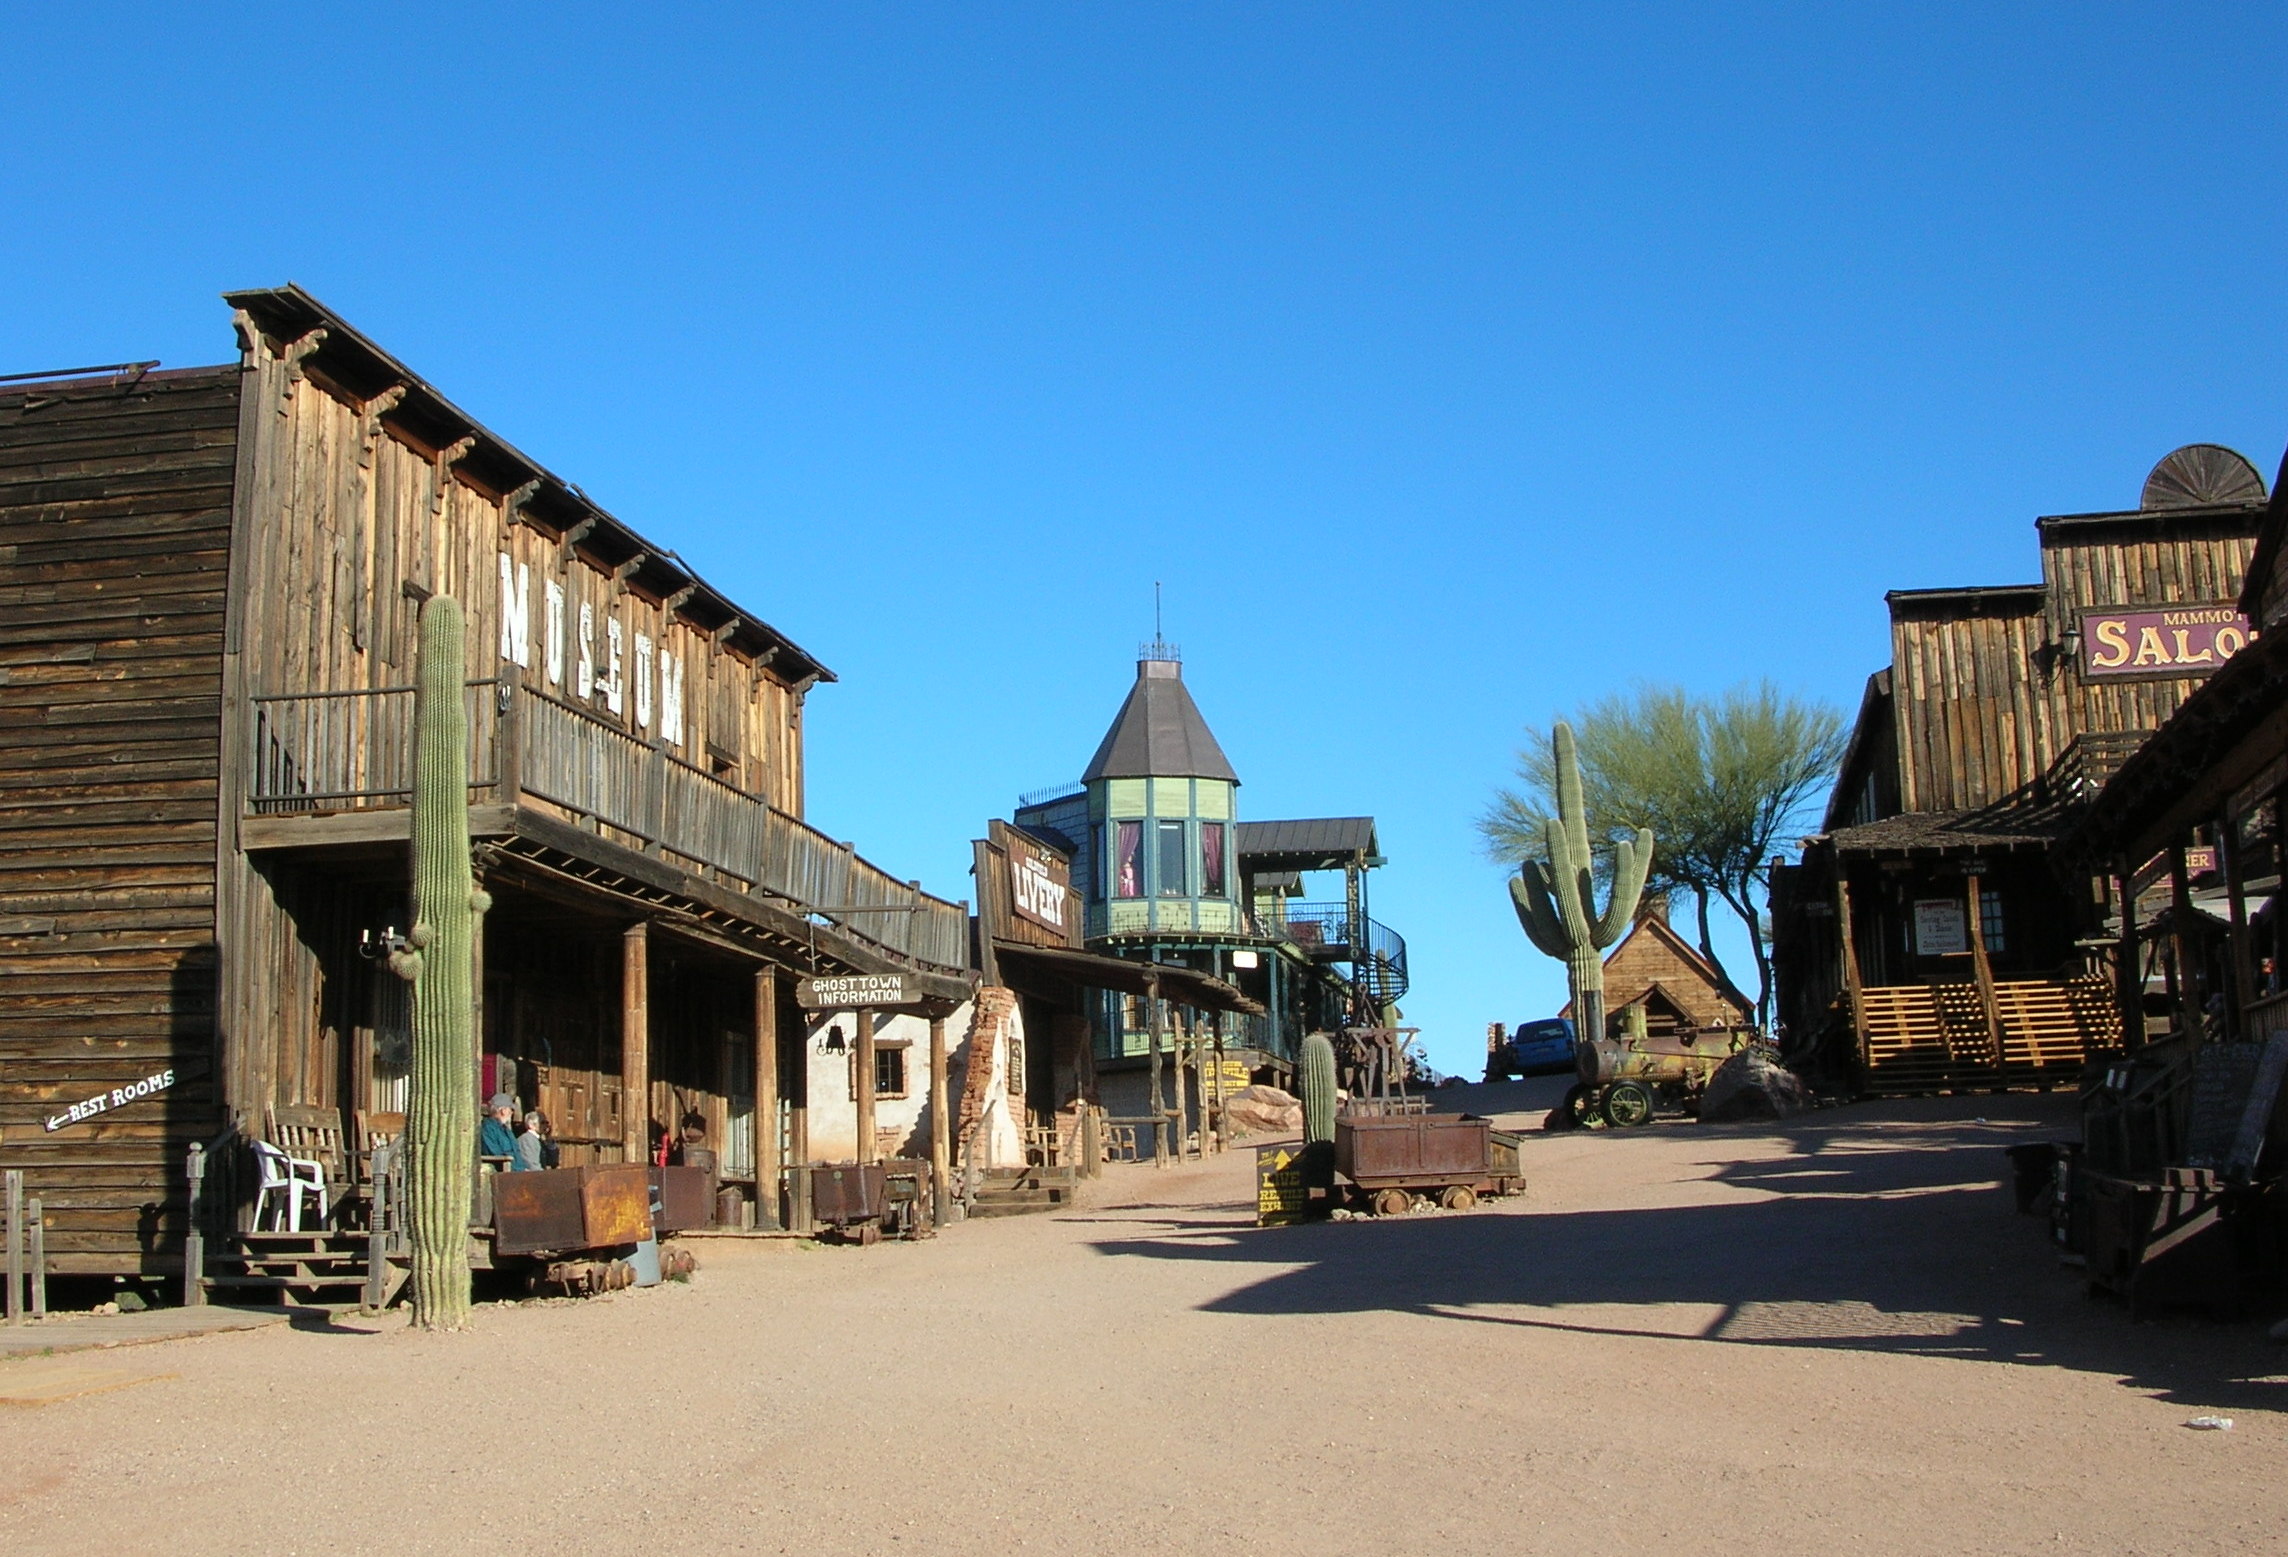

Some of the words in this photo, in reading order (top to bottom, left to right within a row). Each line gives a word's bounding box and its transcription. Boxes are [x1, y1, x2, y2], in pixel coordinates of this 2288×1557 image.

[500, 552, 683, 746] MUSEUM
[2091, 619, 2260, 668] SALO
[1013, 861, 1066, 927] LIVERY
[812, 977, 857, 992] GHOST
[859, 976, 902, 990] TOWN
[818, 989, 902, 1005] INFORMATION
[68, 1093, 107, 1122] REST
[112, 1068, 176, 1107] ROOMS
